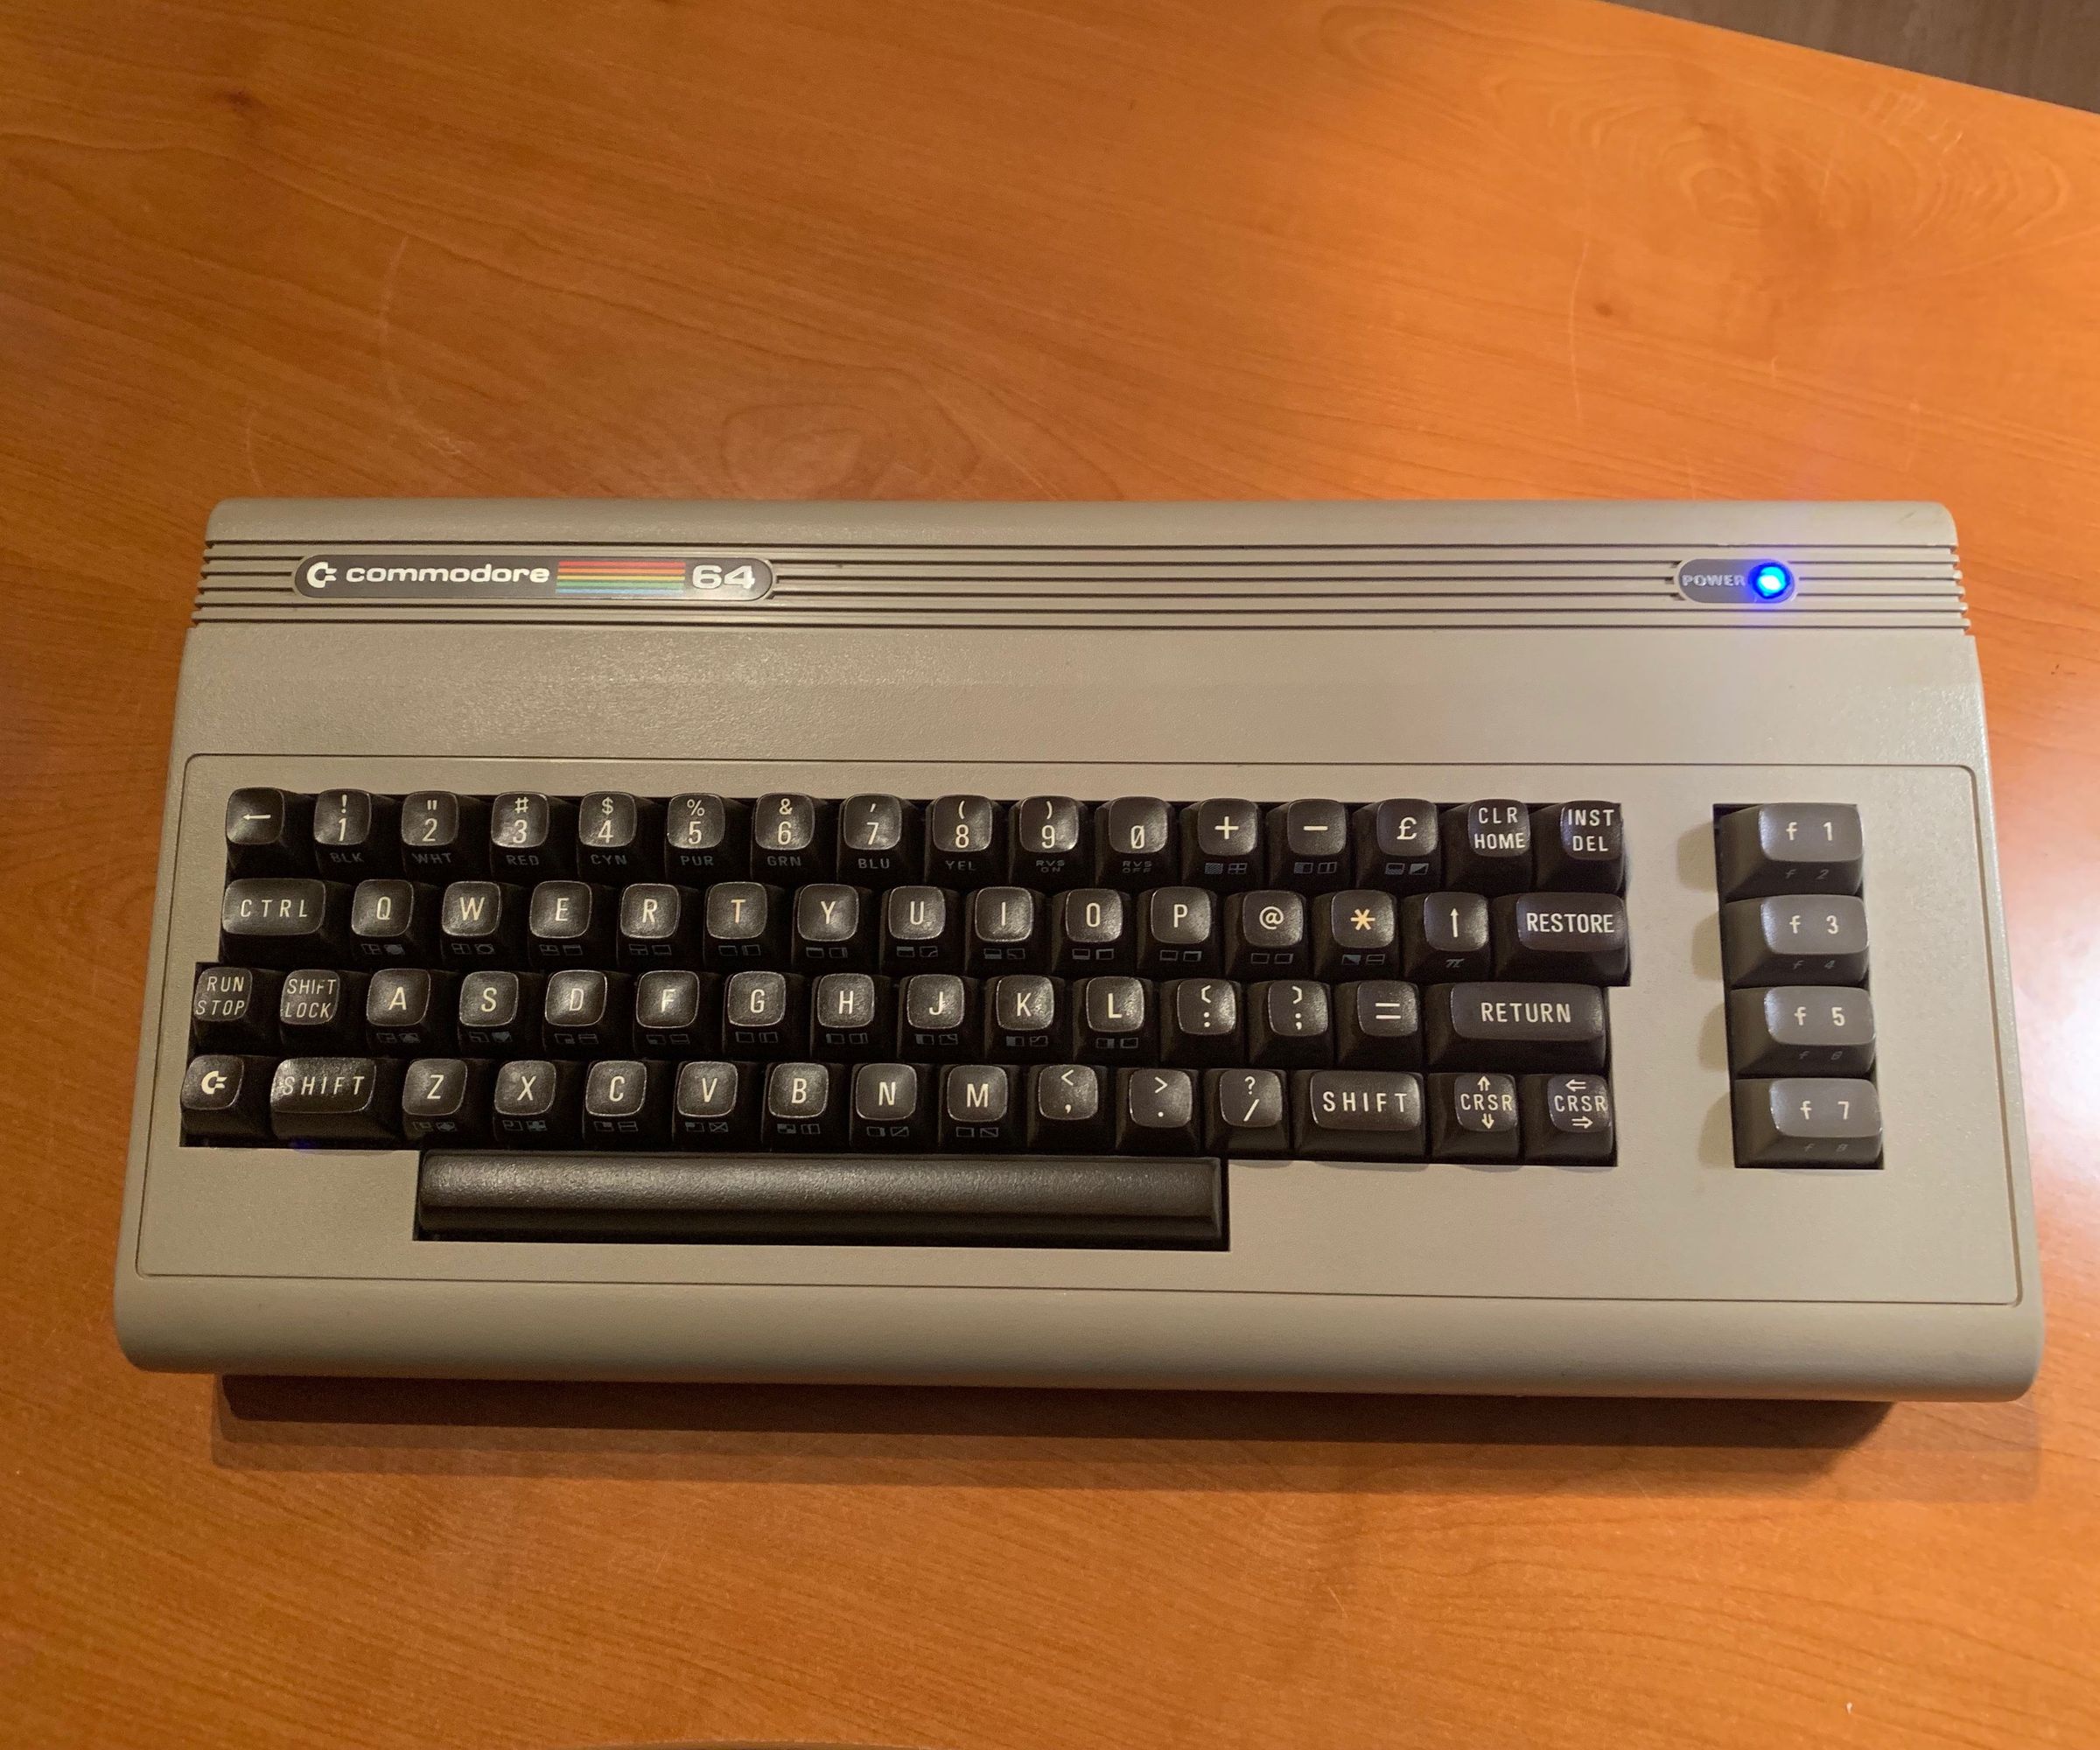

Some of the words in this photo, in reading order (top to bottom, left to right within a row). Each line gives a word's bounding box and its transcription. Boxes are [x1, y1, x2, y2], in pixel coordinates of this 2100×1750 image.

[346, 564, 550, 583] commodore
[692, 565, 755, 590] 64
[1682, 575, 1746, 586] POWER
[340, 794, 347, 814] !
[514, 797, 528, 813] #
[601, 797, 614, 816] $
[687, 799, 705, 817] %
[779, 799, 793, 816] &
[958, 800, 965, 820] (
[1046, 801, 1053, 820] )
[1478, 806, 1519, 824] CLR
[1214, 816, 1239, 840] +
[1396, 817, 1418, 840] £
[1567, 809, 1614, 827] INST
[337, 818, 346, 842] 1
[424, 818, 438, 842] 2
[513, 820, 527, 844] 3
[598, 821, 613, 844] 4
[688, 822, 702, 844] 5
[777, 822, 792, 845] 6
[866, 822, 879, 846] 7
[955, 824, 970, 848] 8
[1041, 825, 1056, 849] 9
[1474, 833, 1526, 850] HOME
[1572, 835, 1608, 851] DEL
[330, 852, 365, 864] BLK
[411, 852, 452, 864] WHT
[506, 854, 540, 866] RED
[590, 853, 628, 866] CYN
[680, 856, 714, 866] PUR
[766, 856, 802, 867] GRN
[858, 858, 891, 870] BLU
[944, 860, 977, 872] YEL
[240, 900, 308, 919] CTRL
[376, 897, 392, 920] Q
[459, 897, 486, 920] W
[556, 898, 570, 921] E
[641, 899, 657, 922] R
[731, 899, 746, 923] T
[821, 900, 836, 925] Y
[910, 901, 924, 925] U
[1086, 903, 1101, 928] O
[1172, 904, 1188, 928] P
[1258, 906, 1284, 929] @
[1526, 912, 1614, 933] RESTORE
[206, 976, 244, 992] RUN
[287, 979, 336, 995] SHIFT
[195, 1000, 245, 1015] STOP
[284, 1002, 331, 1018] LOCK
[389, 987, 408, 1011] A
[481, 988, 498, 1012] S
[570, 988, 584, 1012] D
[660, 989, 676, 1012] F
[751, 989, 765, 1014] G
[838, 990, 854, 1014] H
[928, 991, 945, 1016] J
[1016, 992, 1032, 1017] K
[1108, 993, 1123, 1018] L
[1203, 1012, 1210, 1028] :
[1295, 1012, 1302, 1030] ;
[1375, 1003, 1401, 1019] =
[1480, 1003, 1572, 1023] RETURN
[283, 1075, 365, 1096] SHIFT
[427, 1074, 444, 1100] Z
[517, 1076, 537, 1101] X
[608, 1076, 625, 1102] C
[702, 1078, 718, 1102] V
[791, 1078, 807, 1104] B
[878, 1082, 896, 1105] N
[966, 1083, 990, 1108] M
[1244, 1076, 1256, 1095] ?
[1243, 1098, 1260, 1122] /
[1322, 1092, 1408, 1112] SHIFT
[1460, 1095, 1513, 1111] CRSR
[1554, 1095, 1606, 1113] CRSR
